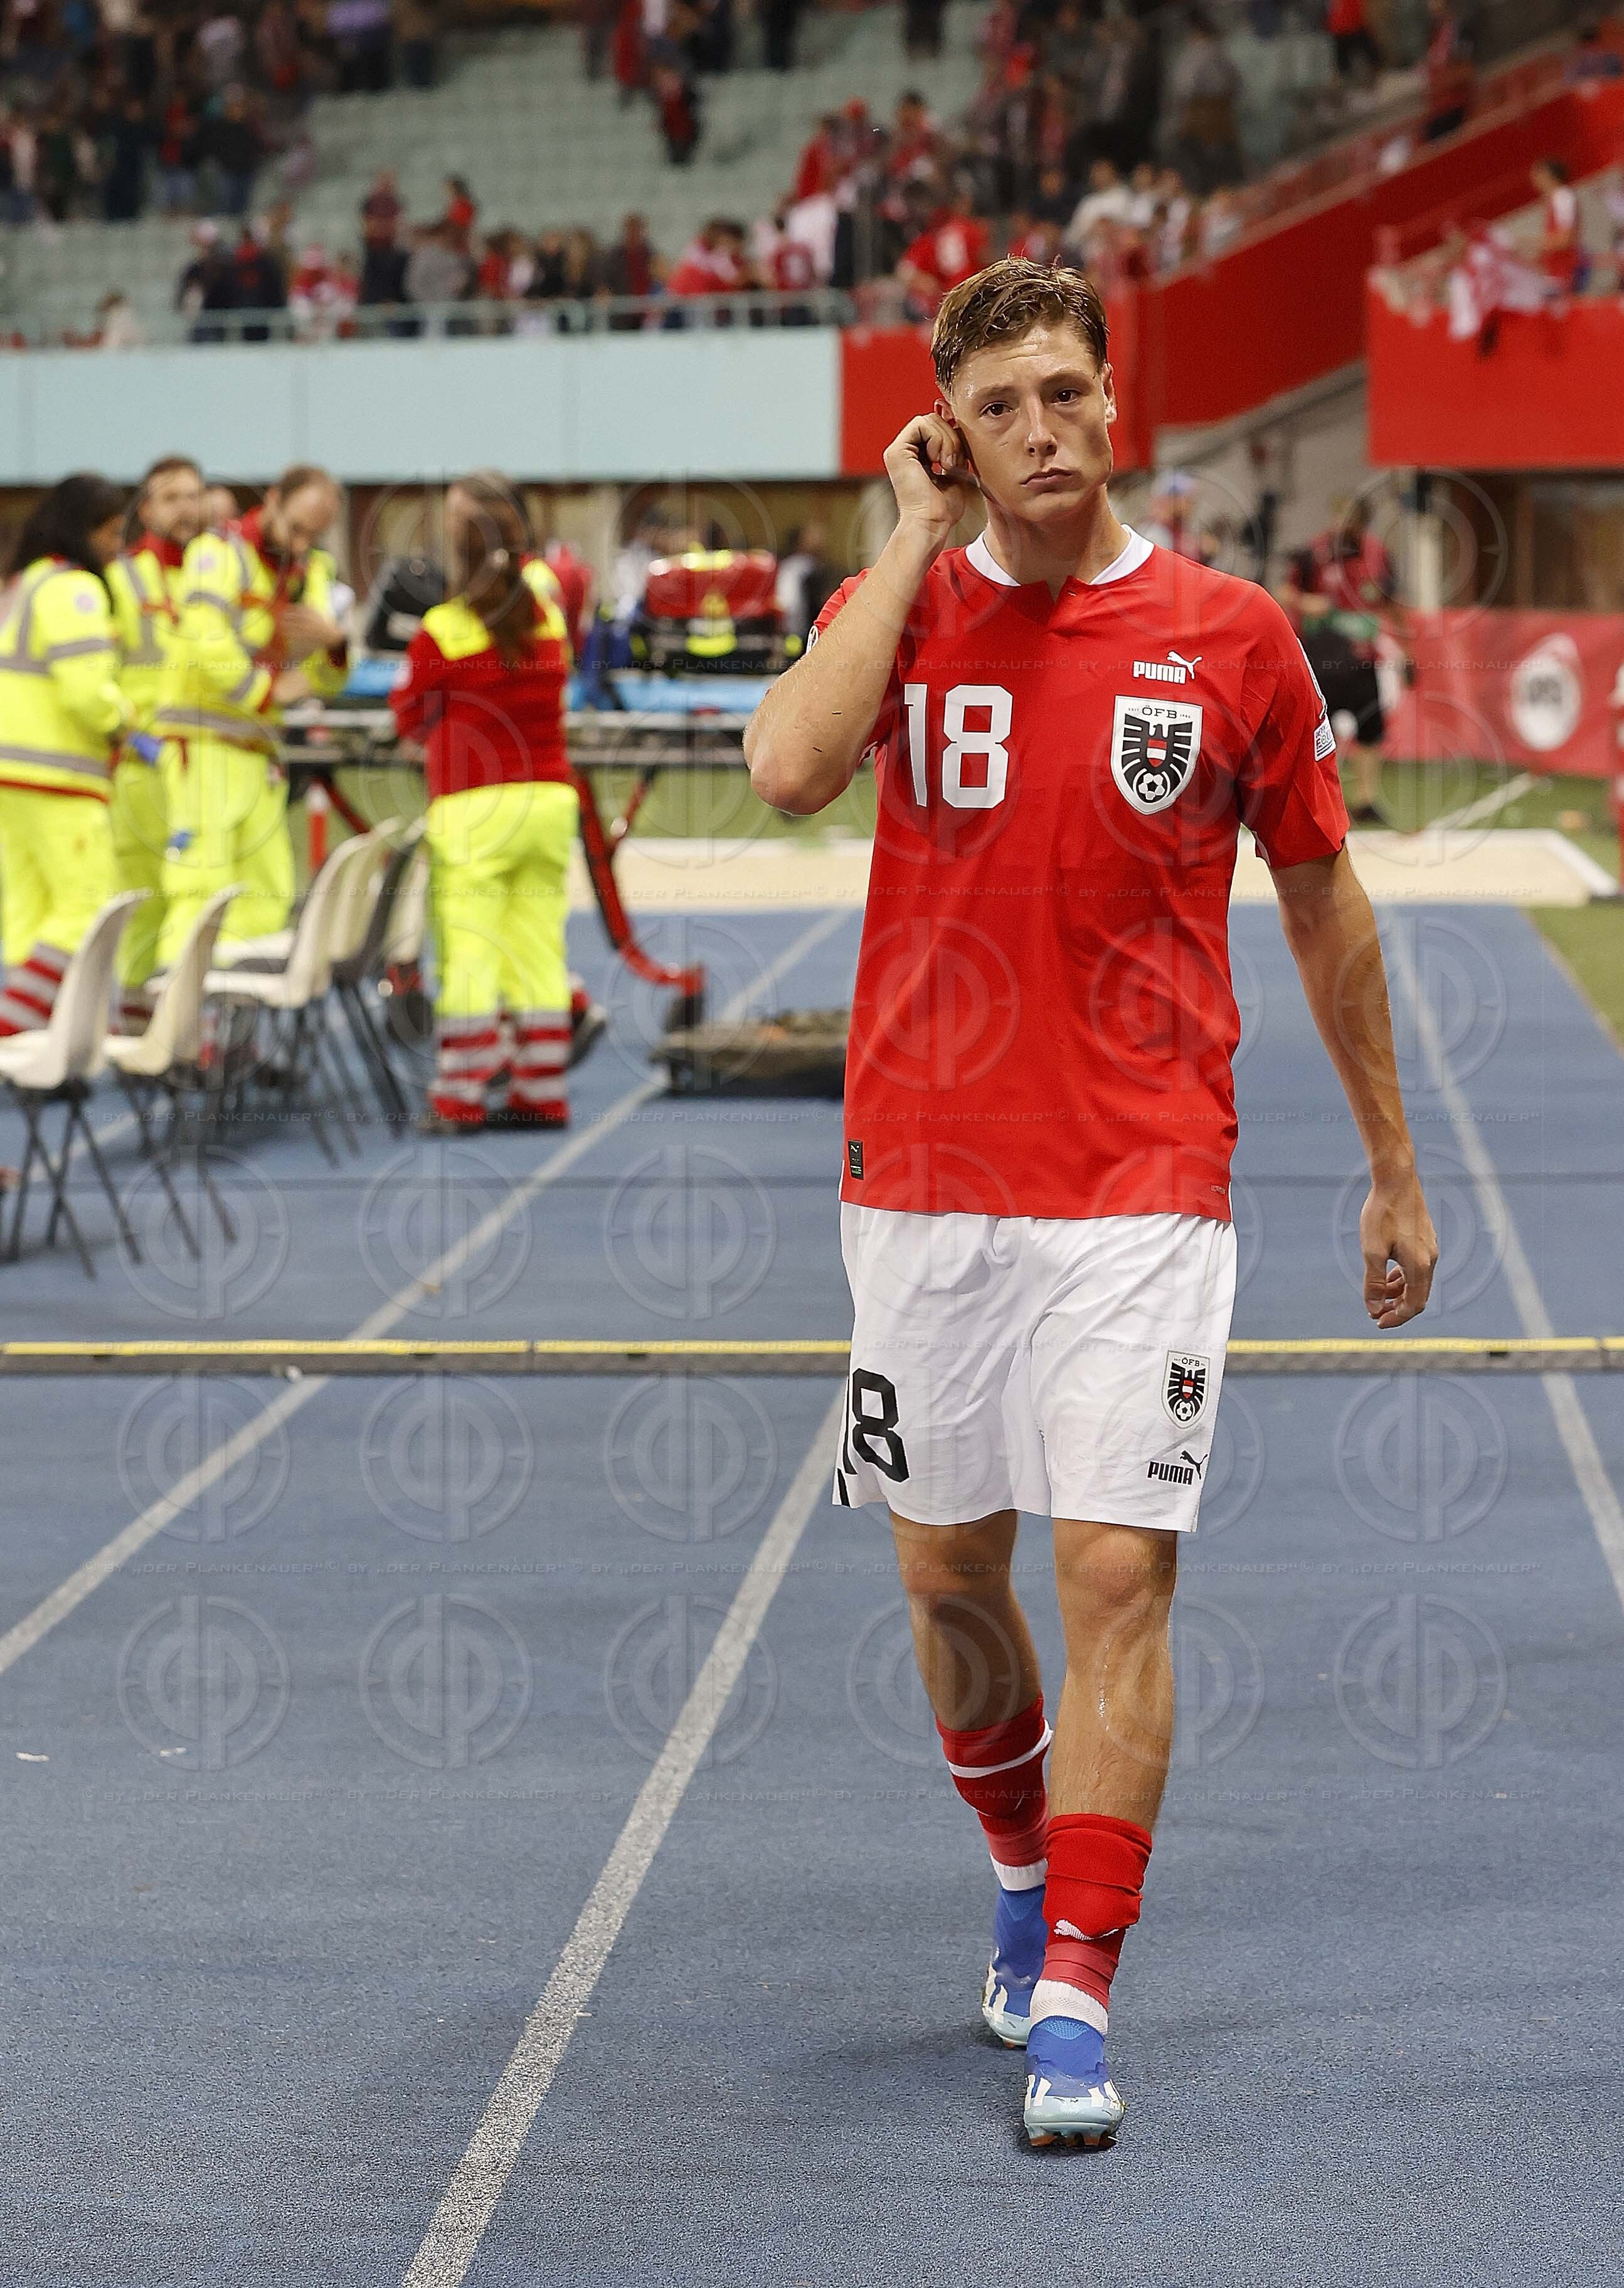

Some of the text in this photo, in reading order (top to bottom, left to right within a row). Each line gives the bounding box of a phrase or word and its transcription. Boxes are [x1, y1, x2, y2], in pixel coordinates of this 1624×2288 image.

[1133, 660, 1186, 684] PUMA
[1142, 704, 1178, 719] ÖFB
[904, 684, 1013, 808] 18
[1181, 1356, 1201, 1367] ÖFB
[1147, 1460, 1194, 1486] PUMA
